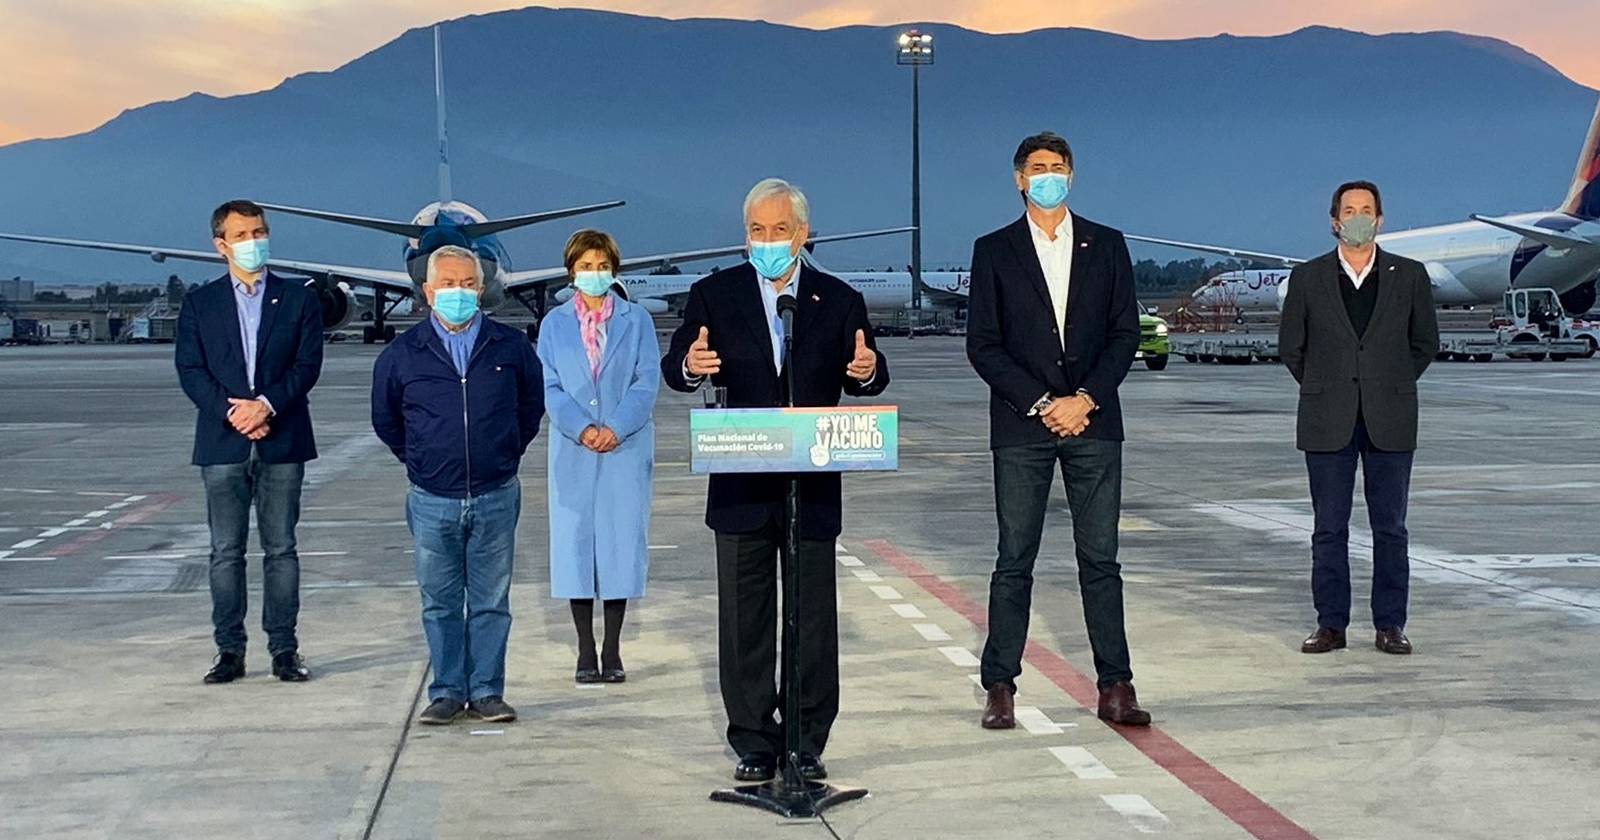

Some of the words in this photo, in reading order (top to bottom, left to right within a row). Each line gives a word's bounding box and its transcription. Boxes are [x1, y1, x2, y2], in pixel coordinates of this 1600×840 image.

[946, 274, 971, 292] Je
[816, 414, 850, 431] #YO
[853, 414, 878, 431] ME
[697, 433, 716, 441] Plan
[718, 432, 756, 441] Nacional
[757, 432, 768, 441] de
[814, 431, 883, 451] VACUNO
[697, 442, 747, 451] Vacunación
[748, 442, 784, 451] Covid-19
